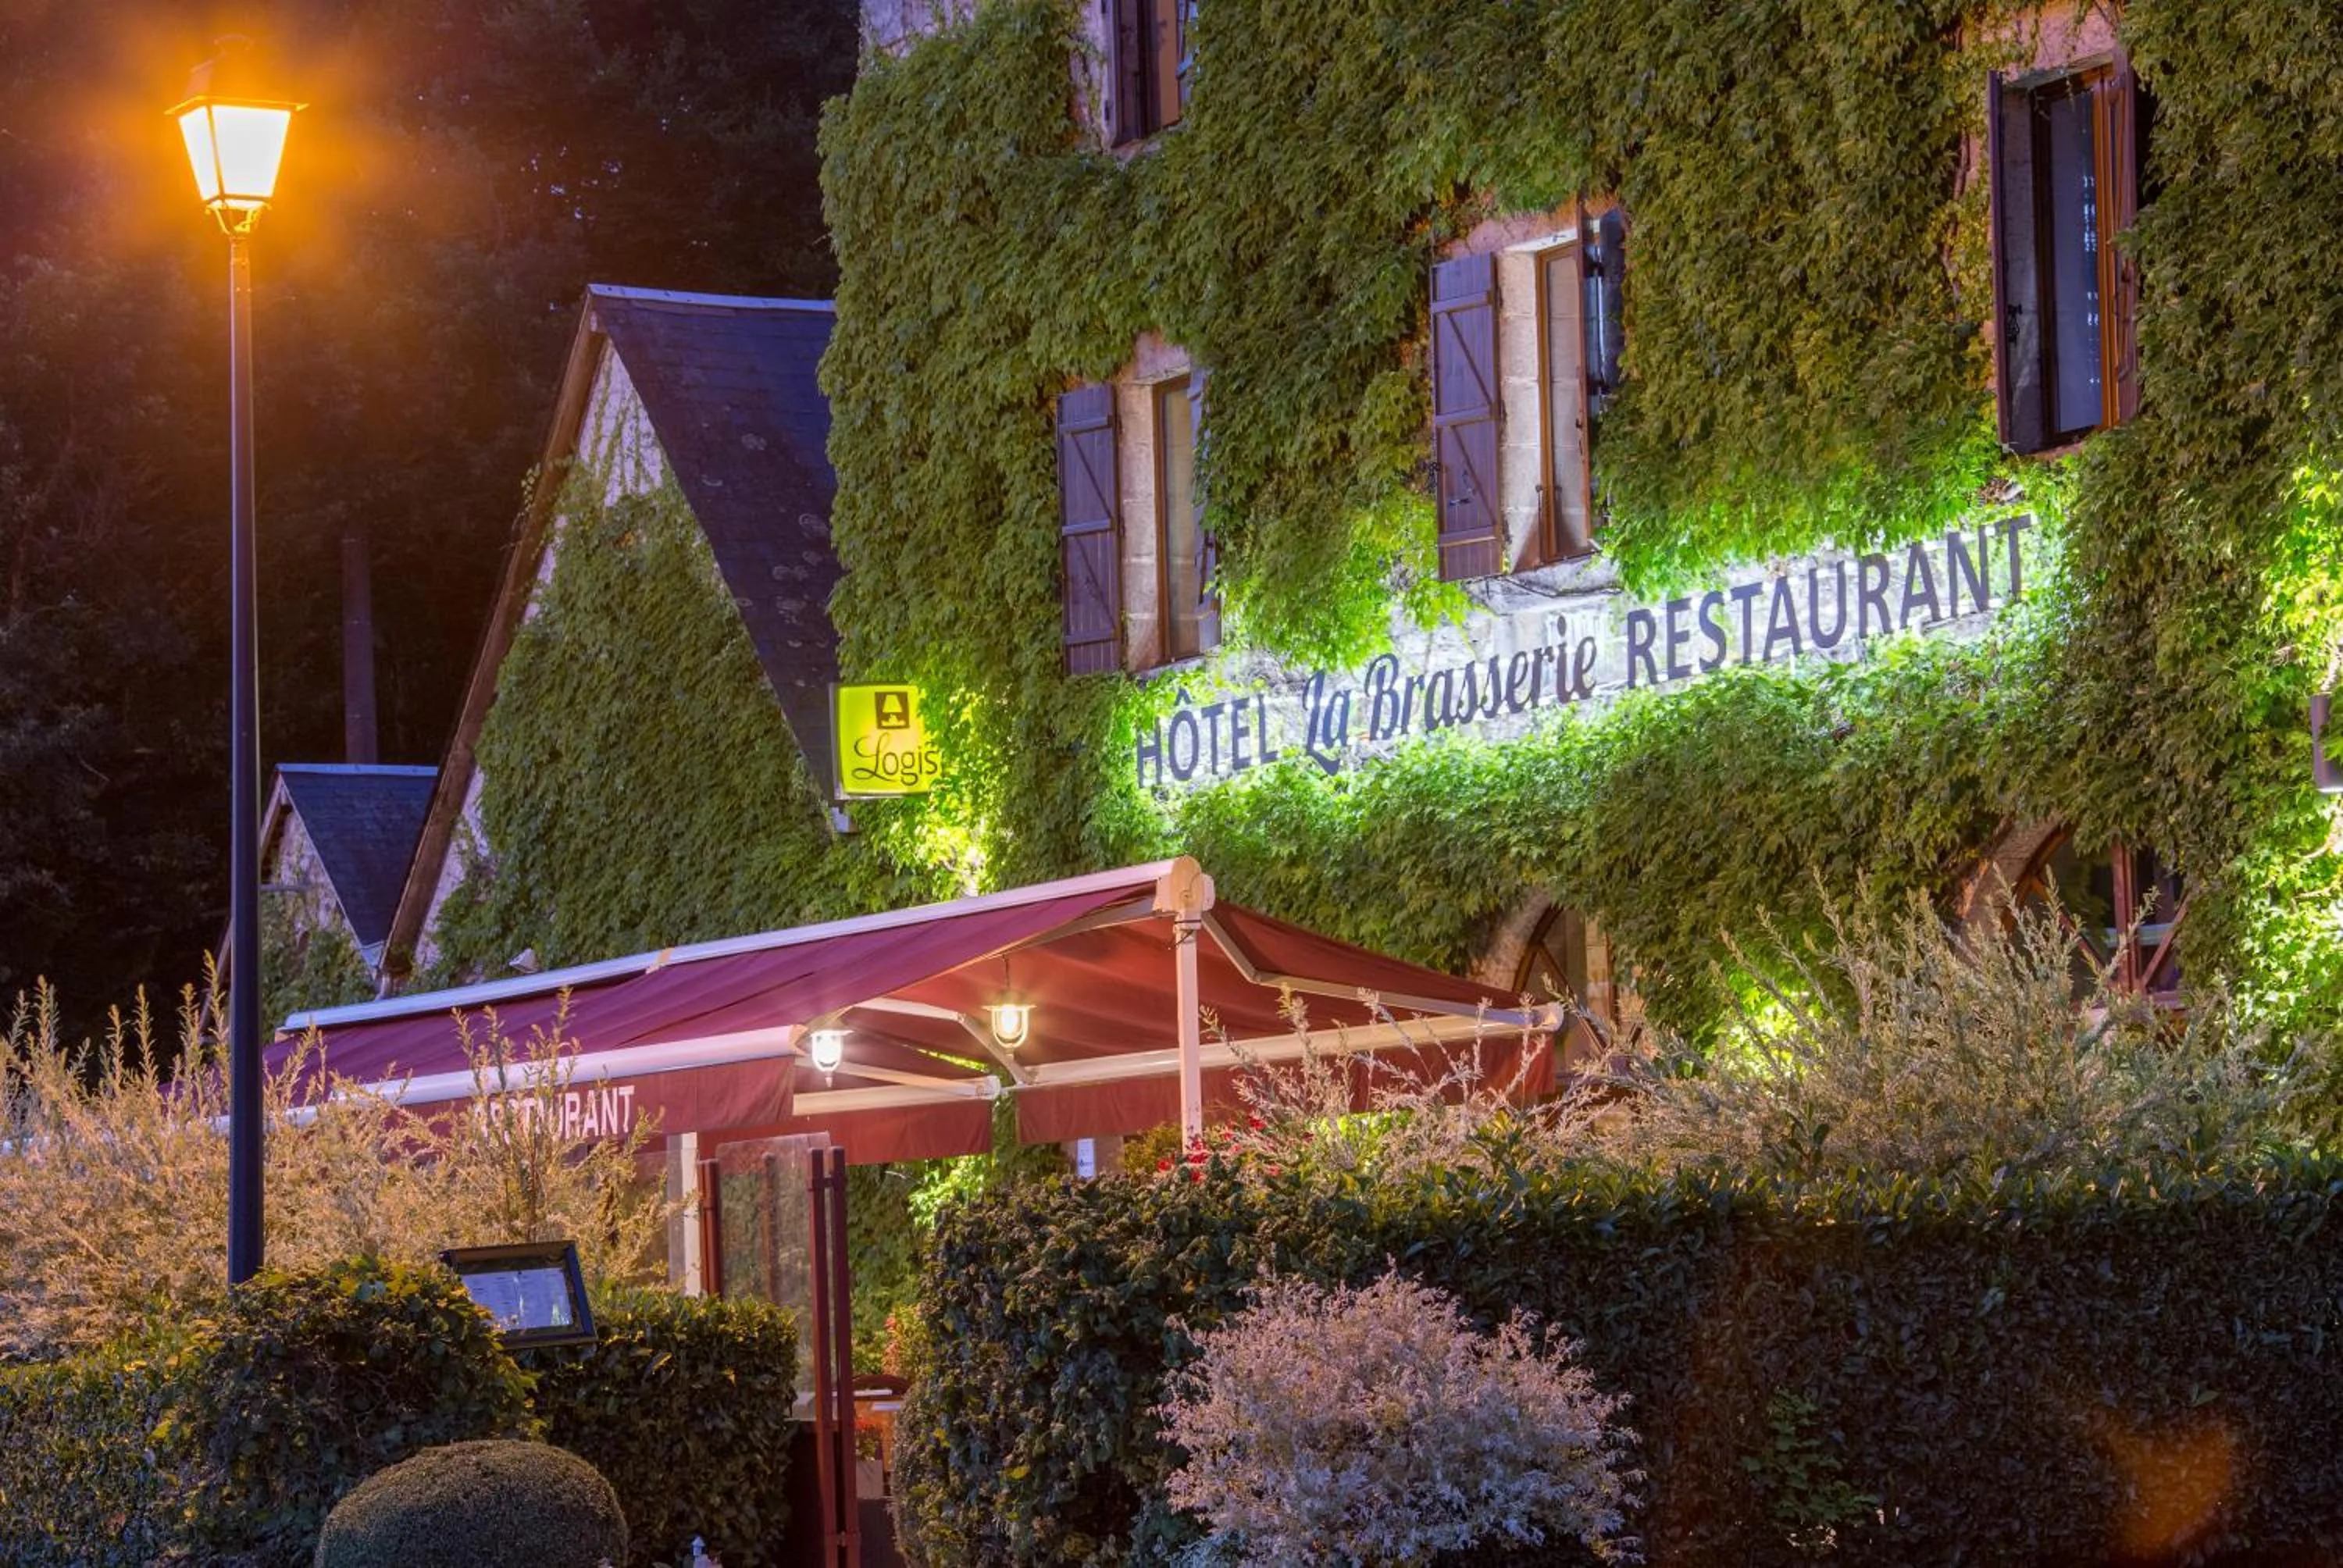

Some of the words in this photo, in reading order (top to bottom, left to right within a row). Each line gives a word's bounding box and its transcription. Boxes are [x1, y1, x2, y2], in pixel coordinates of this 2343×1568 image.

[1136, 686, 1278, 789] HÔTEL
[1302, 669, 1351, 776] La
[1363, 615, 1598, 741] Brasserie
[1626, 513, 2031, 690] RESTAURANT
[851, 732, 939, 786] Logis
